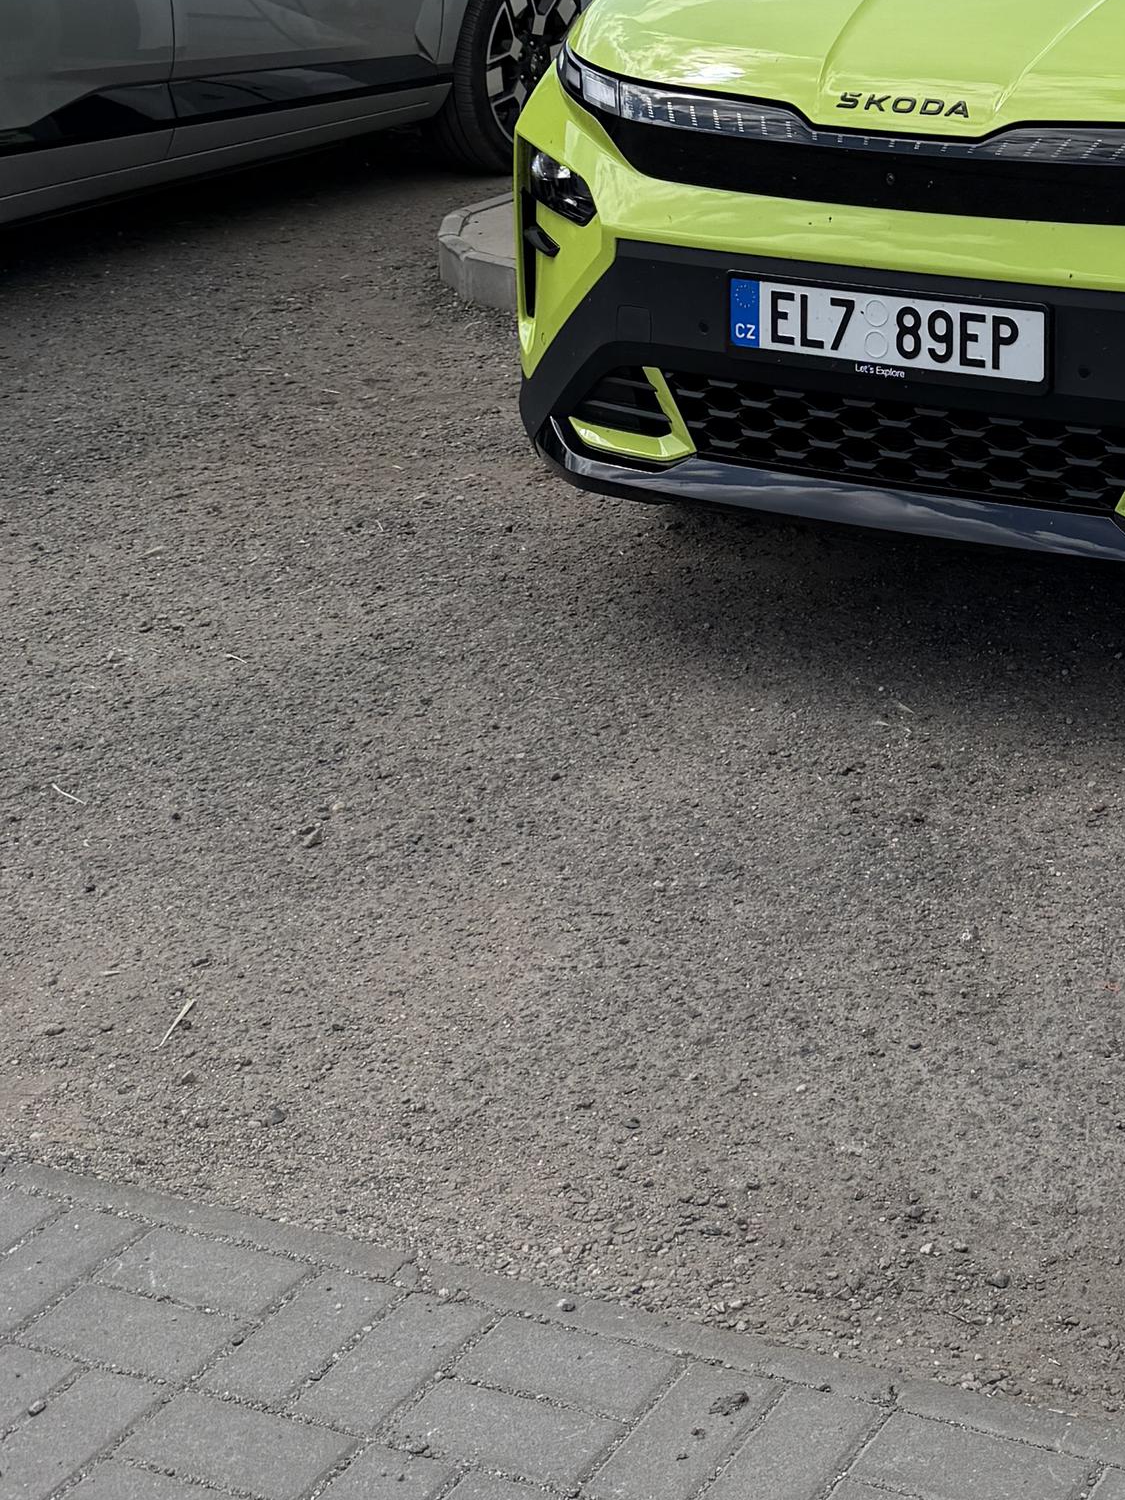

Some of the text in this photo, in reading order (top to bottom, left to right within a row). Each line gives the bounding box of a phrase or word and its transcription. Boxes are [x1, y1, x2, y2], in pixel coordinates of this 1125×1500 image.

[735, 322, 756, 340] CZ
[771, 290, 1019, 370] EL7 89EP
[855, 363, 905, 378] Let's Explore
